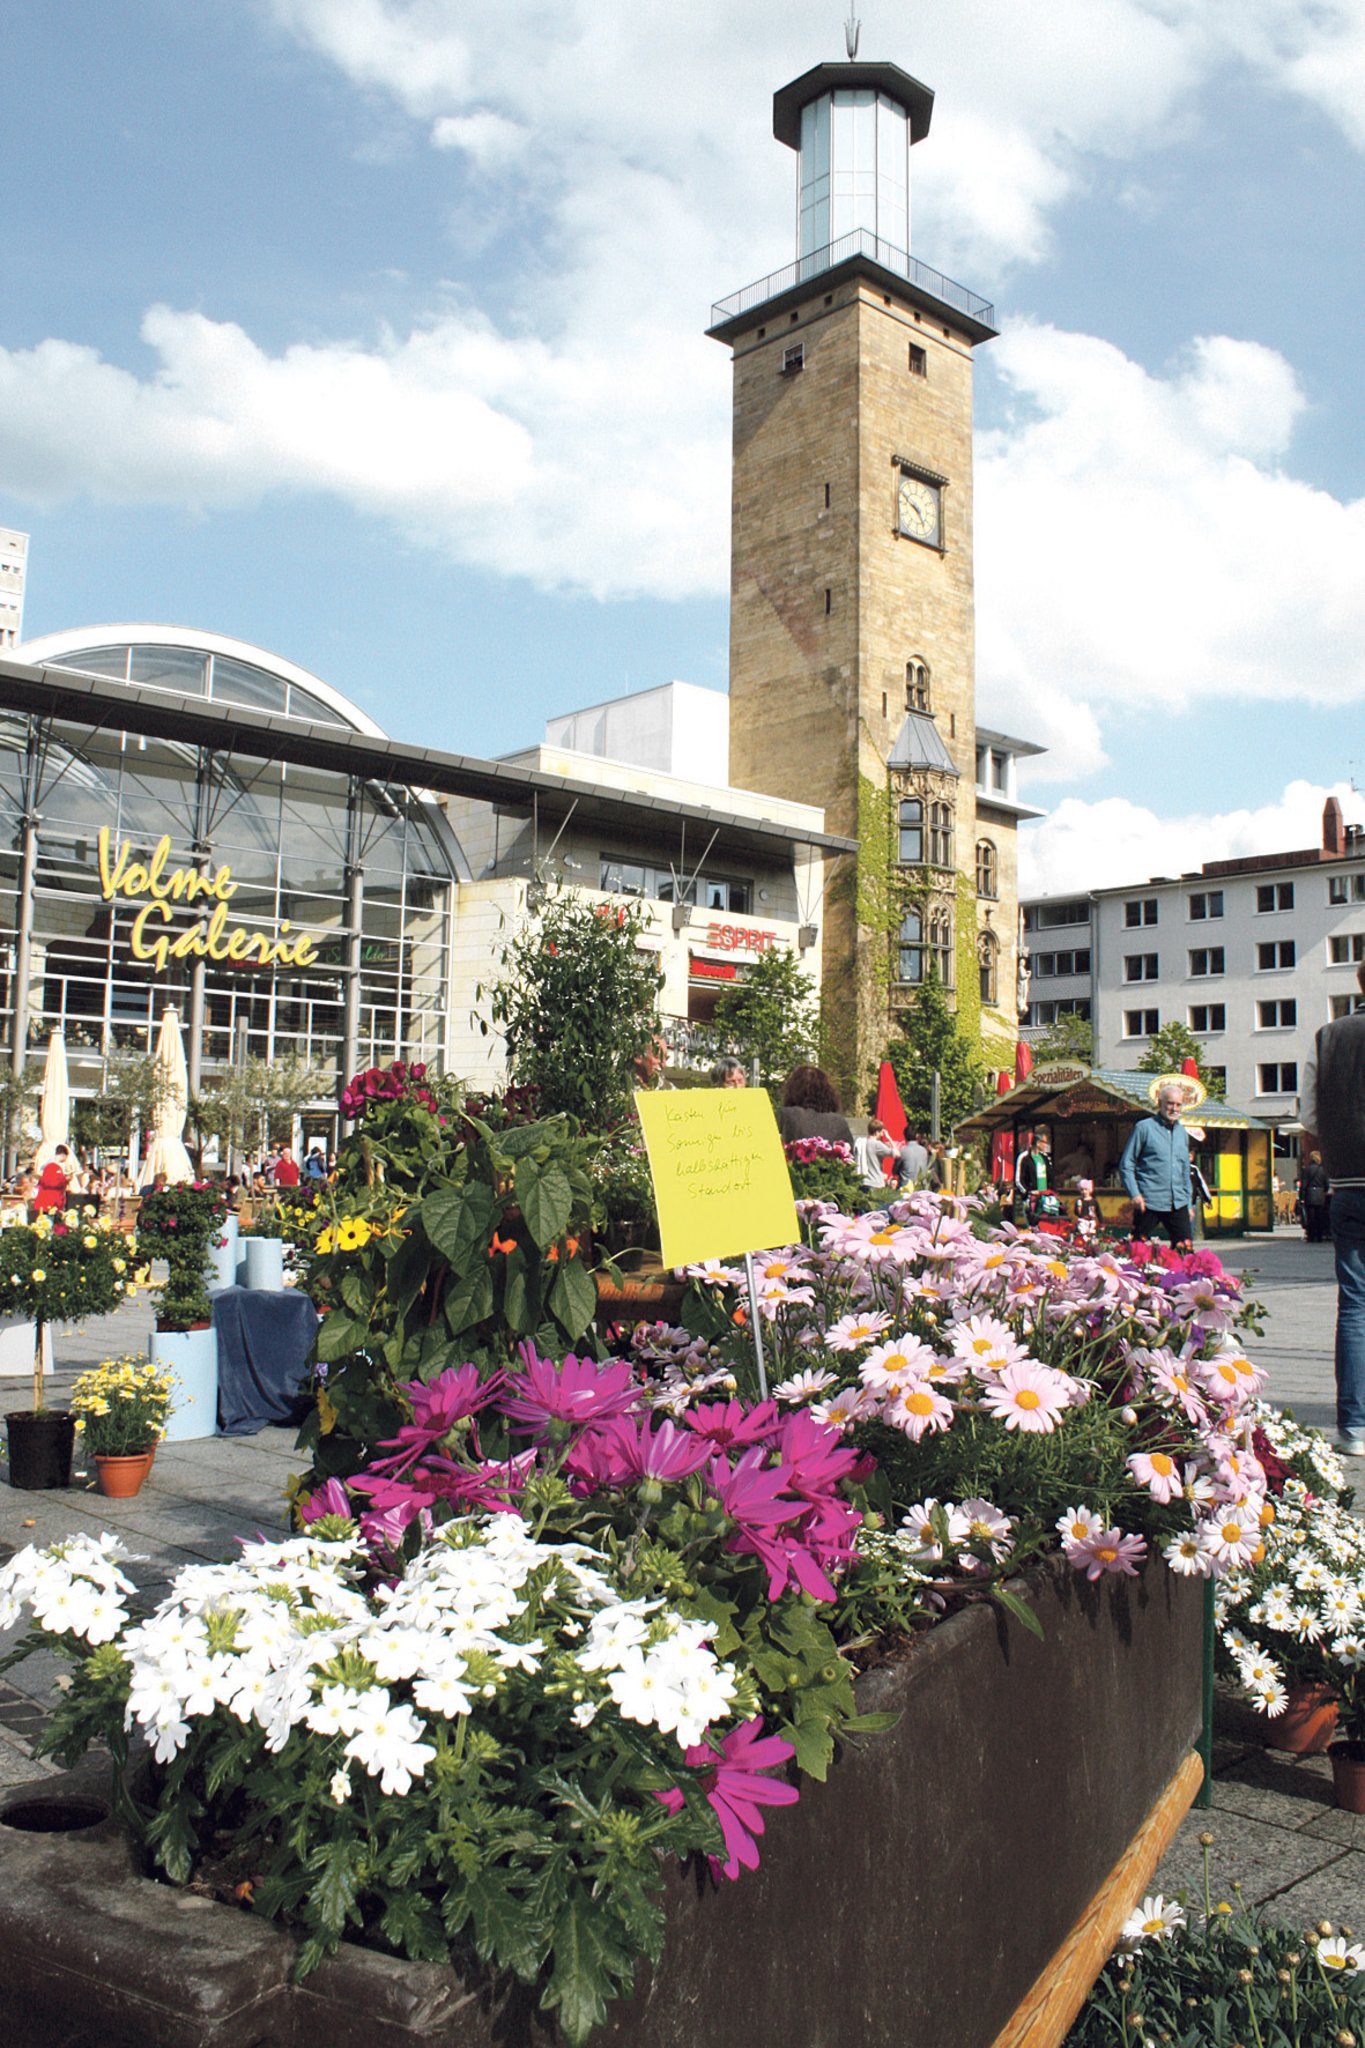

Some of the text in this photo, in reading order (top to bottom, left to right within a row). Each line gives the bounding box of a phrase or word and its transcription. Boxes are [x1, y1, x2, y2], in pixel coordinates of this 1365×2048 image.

[98, 825, 239, 901] Volme
[131, 900, 320, 973] Galerie
[707, 922, 778, 953] ESPRIT
[1031, 1066, 1084, 1088] Spezialitäten
[732, 1124, 754, 1138] bis
[688, 1178, 753, 1199] Standort
